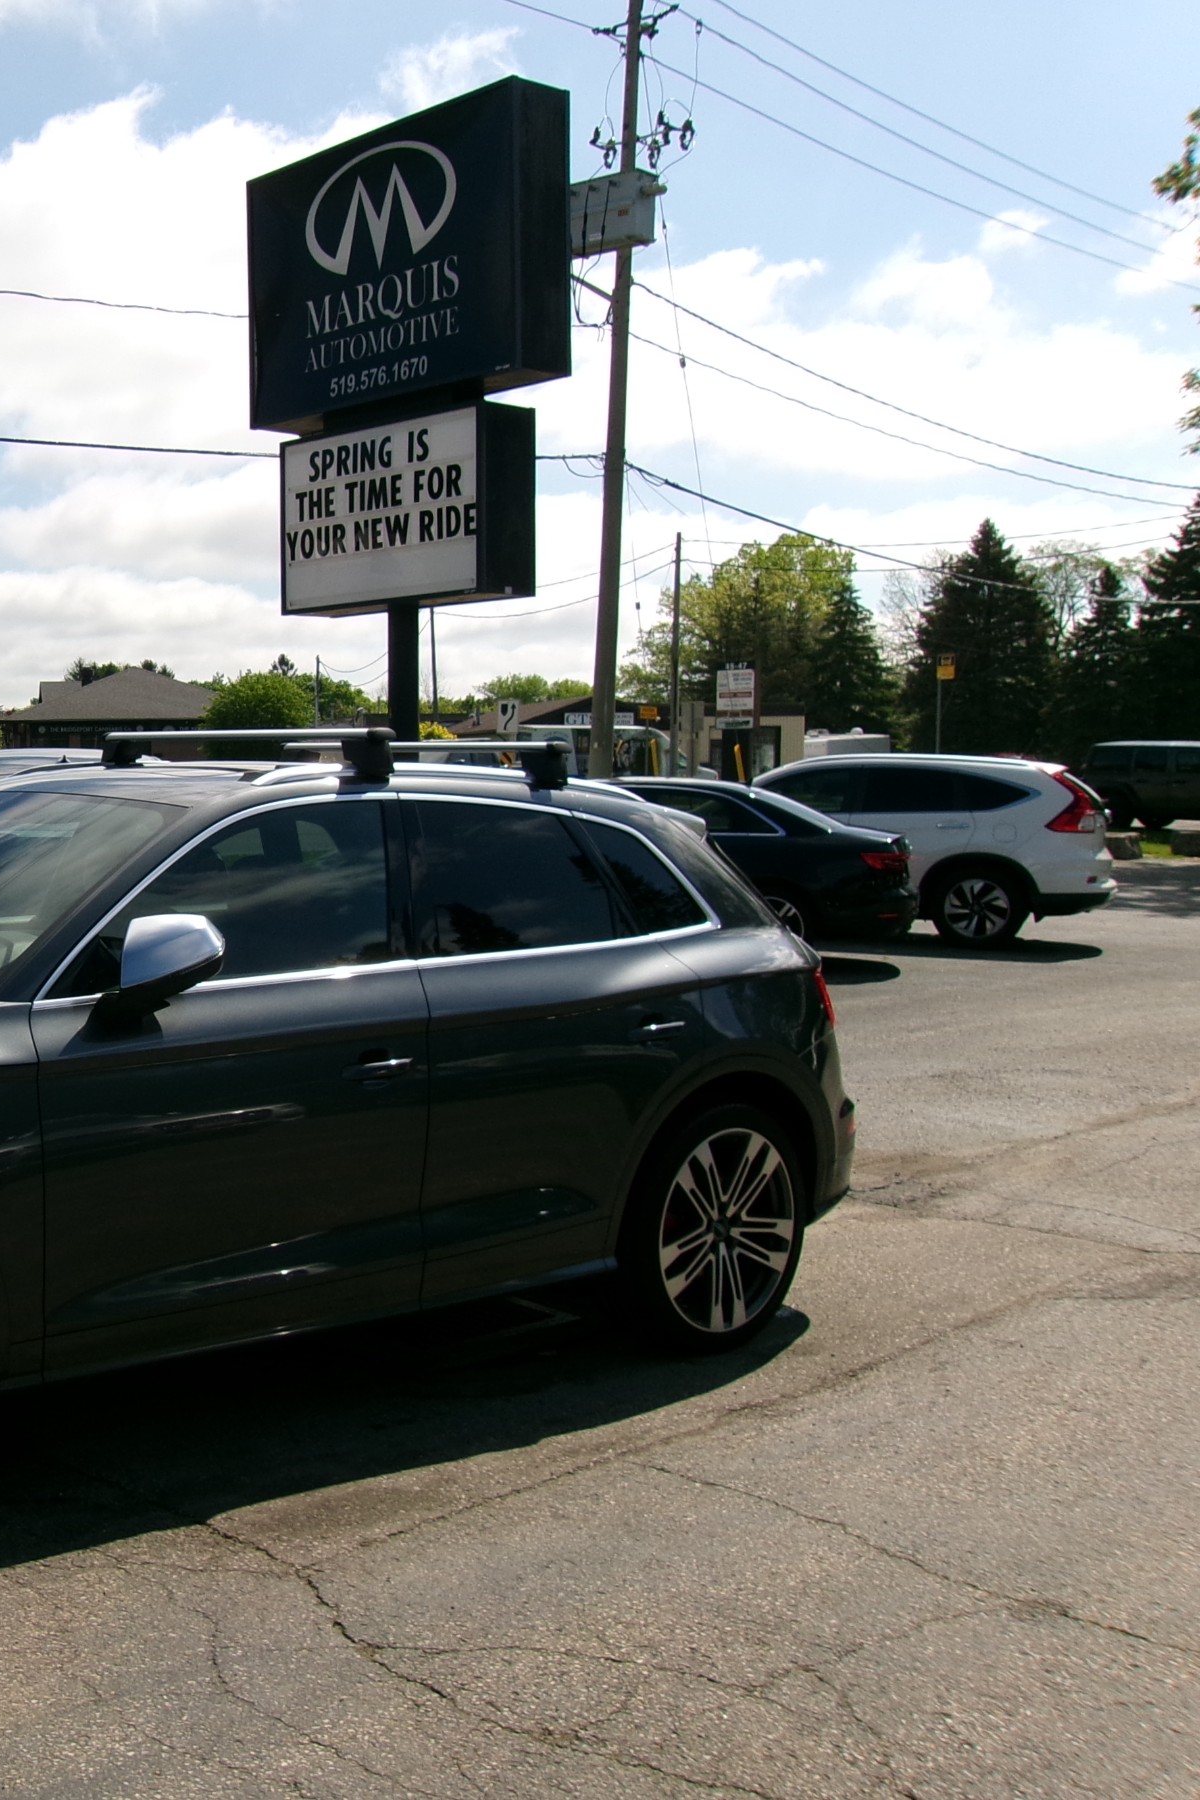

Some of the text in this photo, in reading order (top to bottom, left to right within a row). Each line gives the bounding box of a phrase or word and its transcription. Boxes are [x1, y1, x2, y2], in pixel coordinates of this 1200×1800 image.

[305, 255, 460, 339] MARQUIS
[304, 306, 460, 373] AUTOMOTIVE
[329, 355, 428, 397] 519.576.1670
[309, 428, 429, 482] SPRING IS
[295, 464, 462, 522] THE TIME FOR
[286, 503, 477, 561] YOUR NEW RIDE
